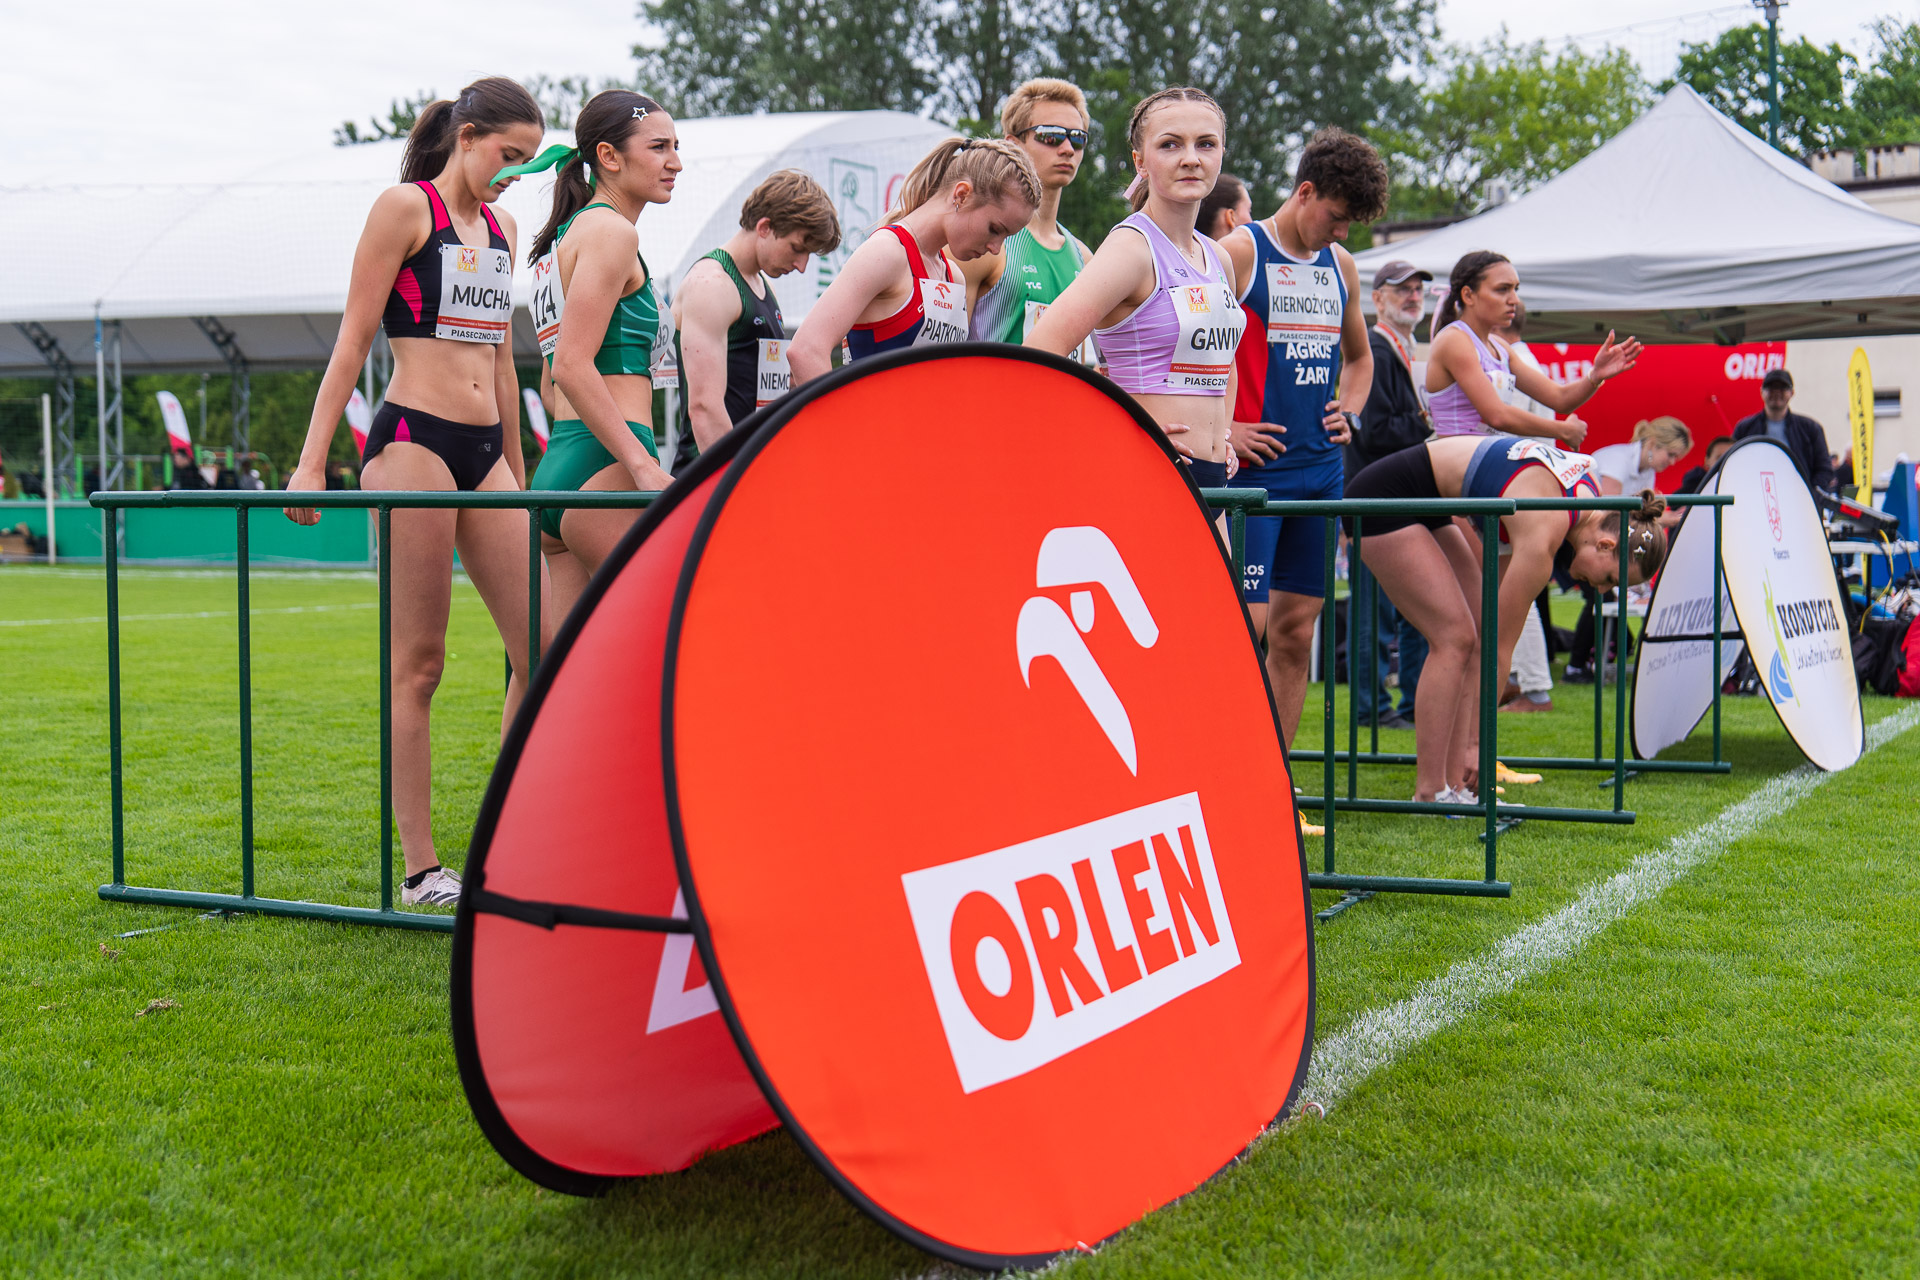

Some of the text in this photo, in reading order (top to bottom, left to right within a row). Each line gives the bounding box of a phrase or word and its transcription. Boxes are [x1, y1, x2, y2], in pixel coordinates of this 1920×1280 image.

[1314, 270, 1329, 286] 96
[452, 284, 510, 310] MUCHA
[534, 279, 557, 330] 114
[933, 299, 952, 310] ORLEN
[1272, 294, 1340, 316] KIERNOŻYCKI
[451, 330, 491, 340] PIASECZNO
[1286, 342, 1332, 360] AGROS
[1295, 362, 1330, 385] ŻARY
[950, 825, 1221, 1042] ORLEN
